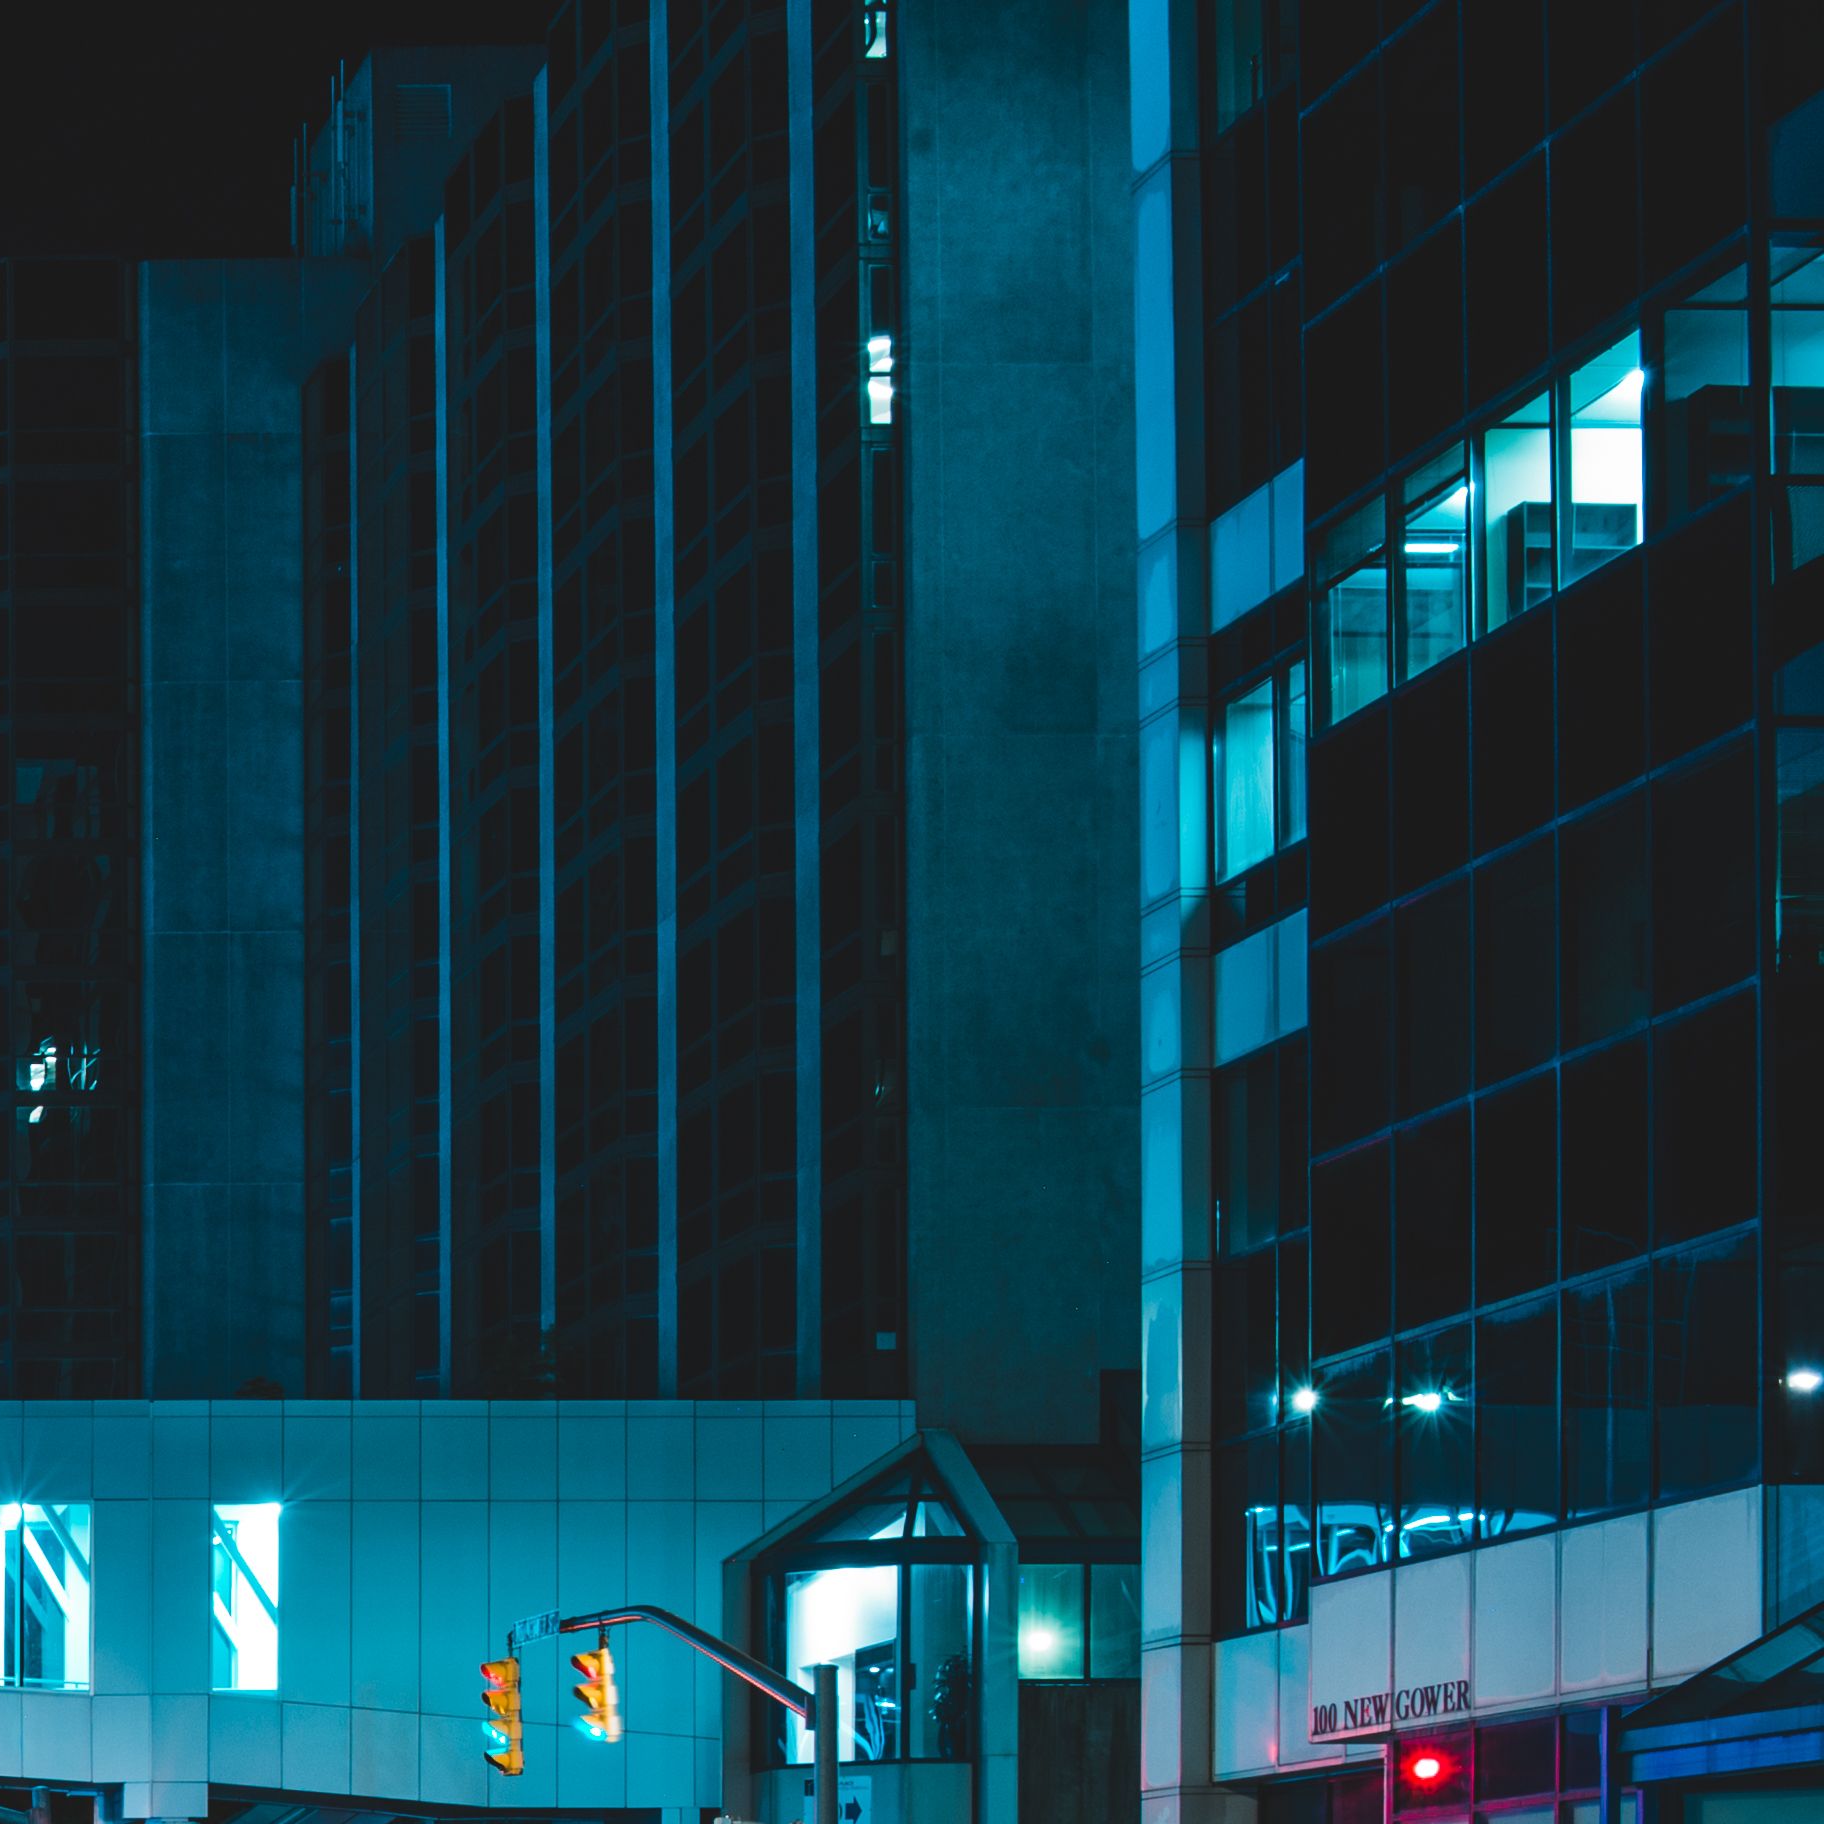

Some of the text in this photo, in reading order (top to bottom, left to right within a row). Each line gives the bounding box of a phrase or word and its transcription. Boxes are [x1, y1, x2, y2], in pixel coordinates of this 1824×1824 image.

[1312, 1679, 1472, 1736] 100 NEW GOWER
